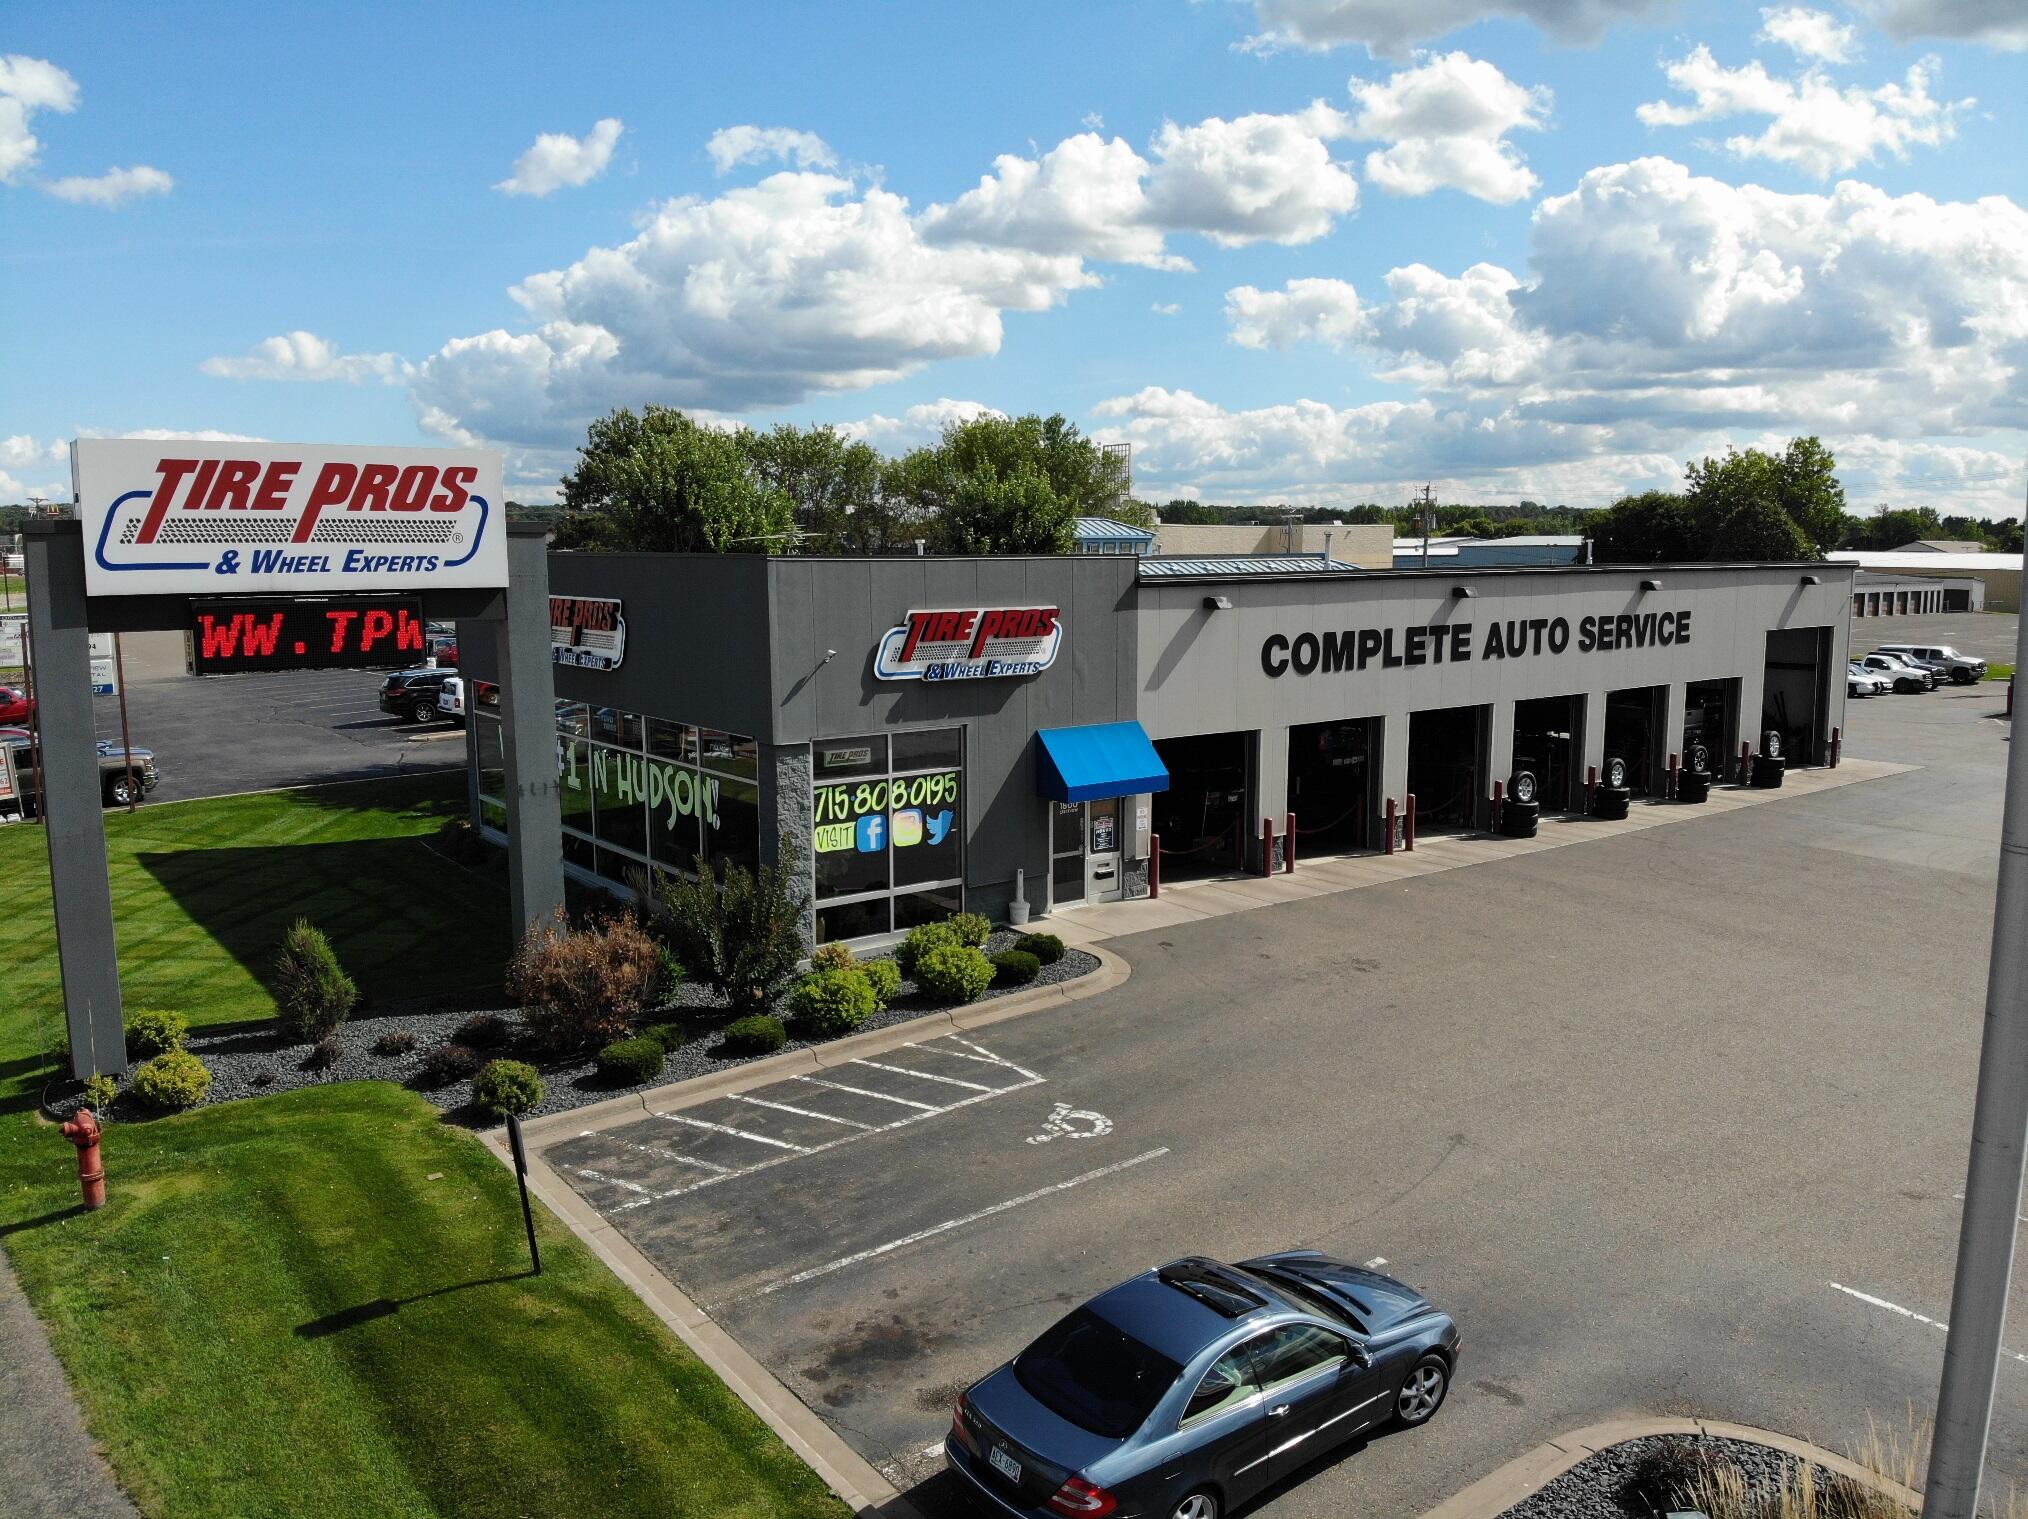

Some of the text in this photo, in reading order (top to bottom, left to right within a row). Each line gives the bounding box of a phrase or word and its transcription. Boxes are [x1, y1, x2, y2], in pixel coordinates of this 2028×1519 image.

[136, 458, 479, 544] TIRE PROS
[214, 549, 440, 574] & WHEEL EXPERTS
[570, 599, 614, 647] PROS
[899, 608, 1061, 663] TIRE PROS
[1261, 610, 1692, 678] COMPLETE AUTO SERVICE
[928, 660, 1041, 680] & WHEEL EXPERTS
[616, 752, 721, 831] HUDSON!
[817, 825, 853, 849] VISIT
